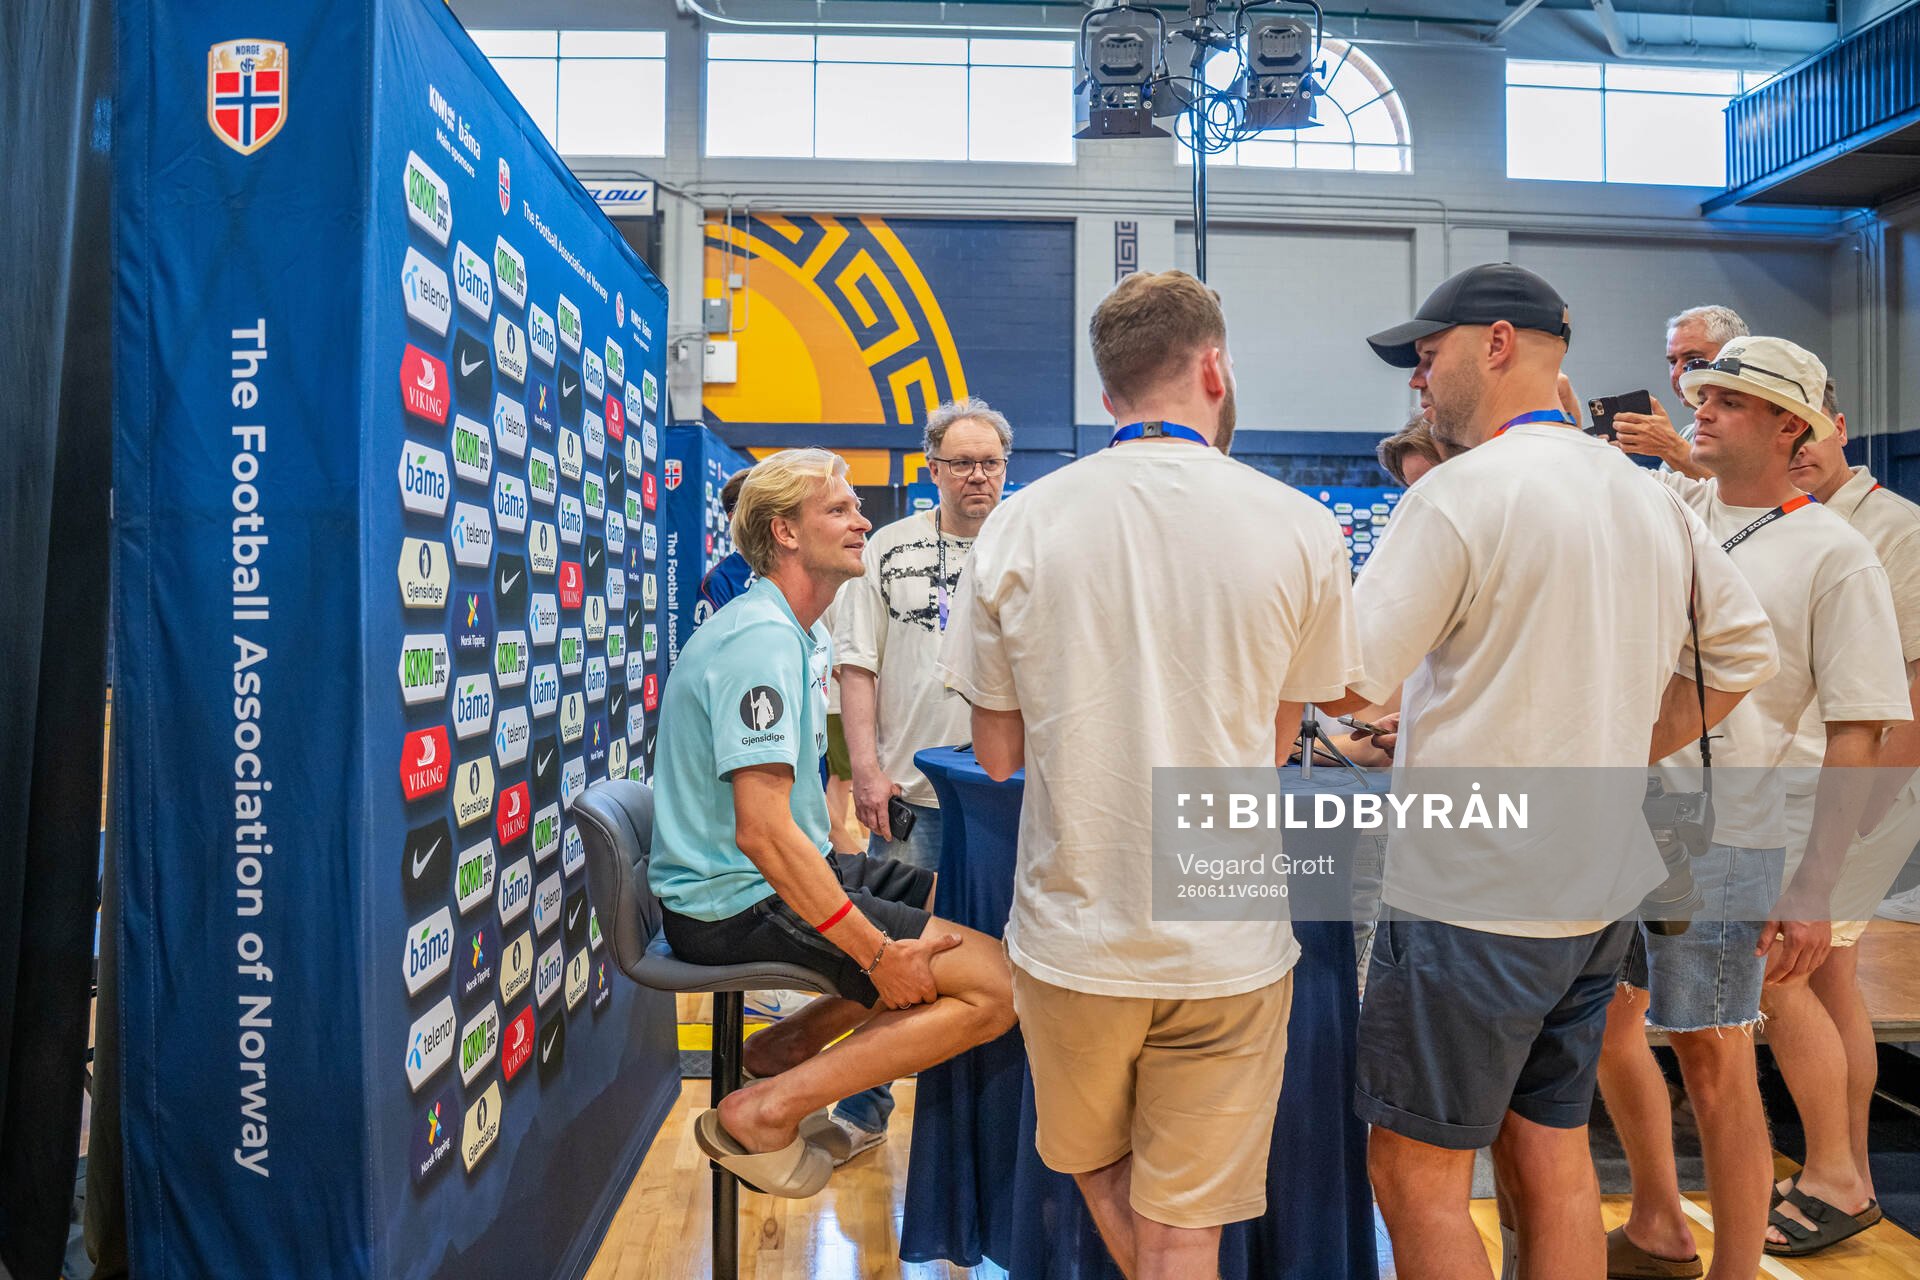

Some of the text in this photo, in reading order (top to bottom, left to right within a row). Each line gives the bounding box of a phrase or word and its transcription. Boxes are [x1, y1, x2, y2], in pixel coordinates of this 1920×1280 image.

[236, 45, 260, 55] NORGE
[430, 83, 448, 124] KIWI
[436, 127, 475, 178] Main sponsors
[458, 115, 480, 160] bama
[410, 164, 436, 222] KIWI
[438, 194, 448, 215] mini
[438, 213, 447, 232] pris
[498, 246, 516, 290] KIWI
[523, 200, 534, 225] The
[535, 213, 558, 250] Football
[558, 240, 586, 280] Association
[592, 274, 608, 304] Norway
[420, 276, 448, 312] telenor
[459, 252, 488, 306] bama
[532, 312, 554, 354] bama
[499, 350, 523, 378] Gjensidige
[409, 386, 442, 417] VIKING
[505, 414, 526, 438] telenor
[456, 427, 480, 468] KIWI
[480, 438, 489, 454] mini
[406, 452, 444, 500] bama
[480, 454, 488, 472] pris
[532, 458, 548, 491] KIWI
[499, 482, 524, 519] bama
[562, 502, 580, 532] bama
[466, 522, 490, 546] telenor
[668, 532, 678, 556] The
[1732, 530, 1748, 543] CUP
[406, 582, 442, 603] Gjensidige
[668, 560, 679, 610] Football
[434, 648, 446, 666] mini
[460, 636, 472, 646] Norsk
[404, 648, 434, 688] KIWI
[498, 642, 518, 674] KIWI
[434, 667, 445, 688] pris
[534, 675, 556, 704] bama
[588, 666, 604, 692] bama
[458, 688, 489, 722] bama
[231, 318, 273, 1178] The Football Association of Norway
[508, 724, 528, 744] telenor
[741, 732, 786, 746] Gjensidige
[409, 765, 443, 792] VIKING
[460, 796, 489, 820] Gjensidige
[502, 814, 526, 838] VIKING
[534, 816, 552, 852] KIWI
[460, 855, 483, 901] KIWI
[502, 873, 528, 912] bama
[544, 888, 560, 912] telenor
[410, 928, 448, 978] bama
[505, 967, 529, 997] Gjensidige
[539, 956, 560, 994] bama
[424, 1016, 454, 1055] telenor
[463, 1020, 487, 1074] KIWI
[508, 1038, 530, 1072] VIKING
[420, 1137, 450, 1176] Norsk Tipping
[468, 1122, 496, 1162] Gjensidige
